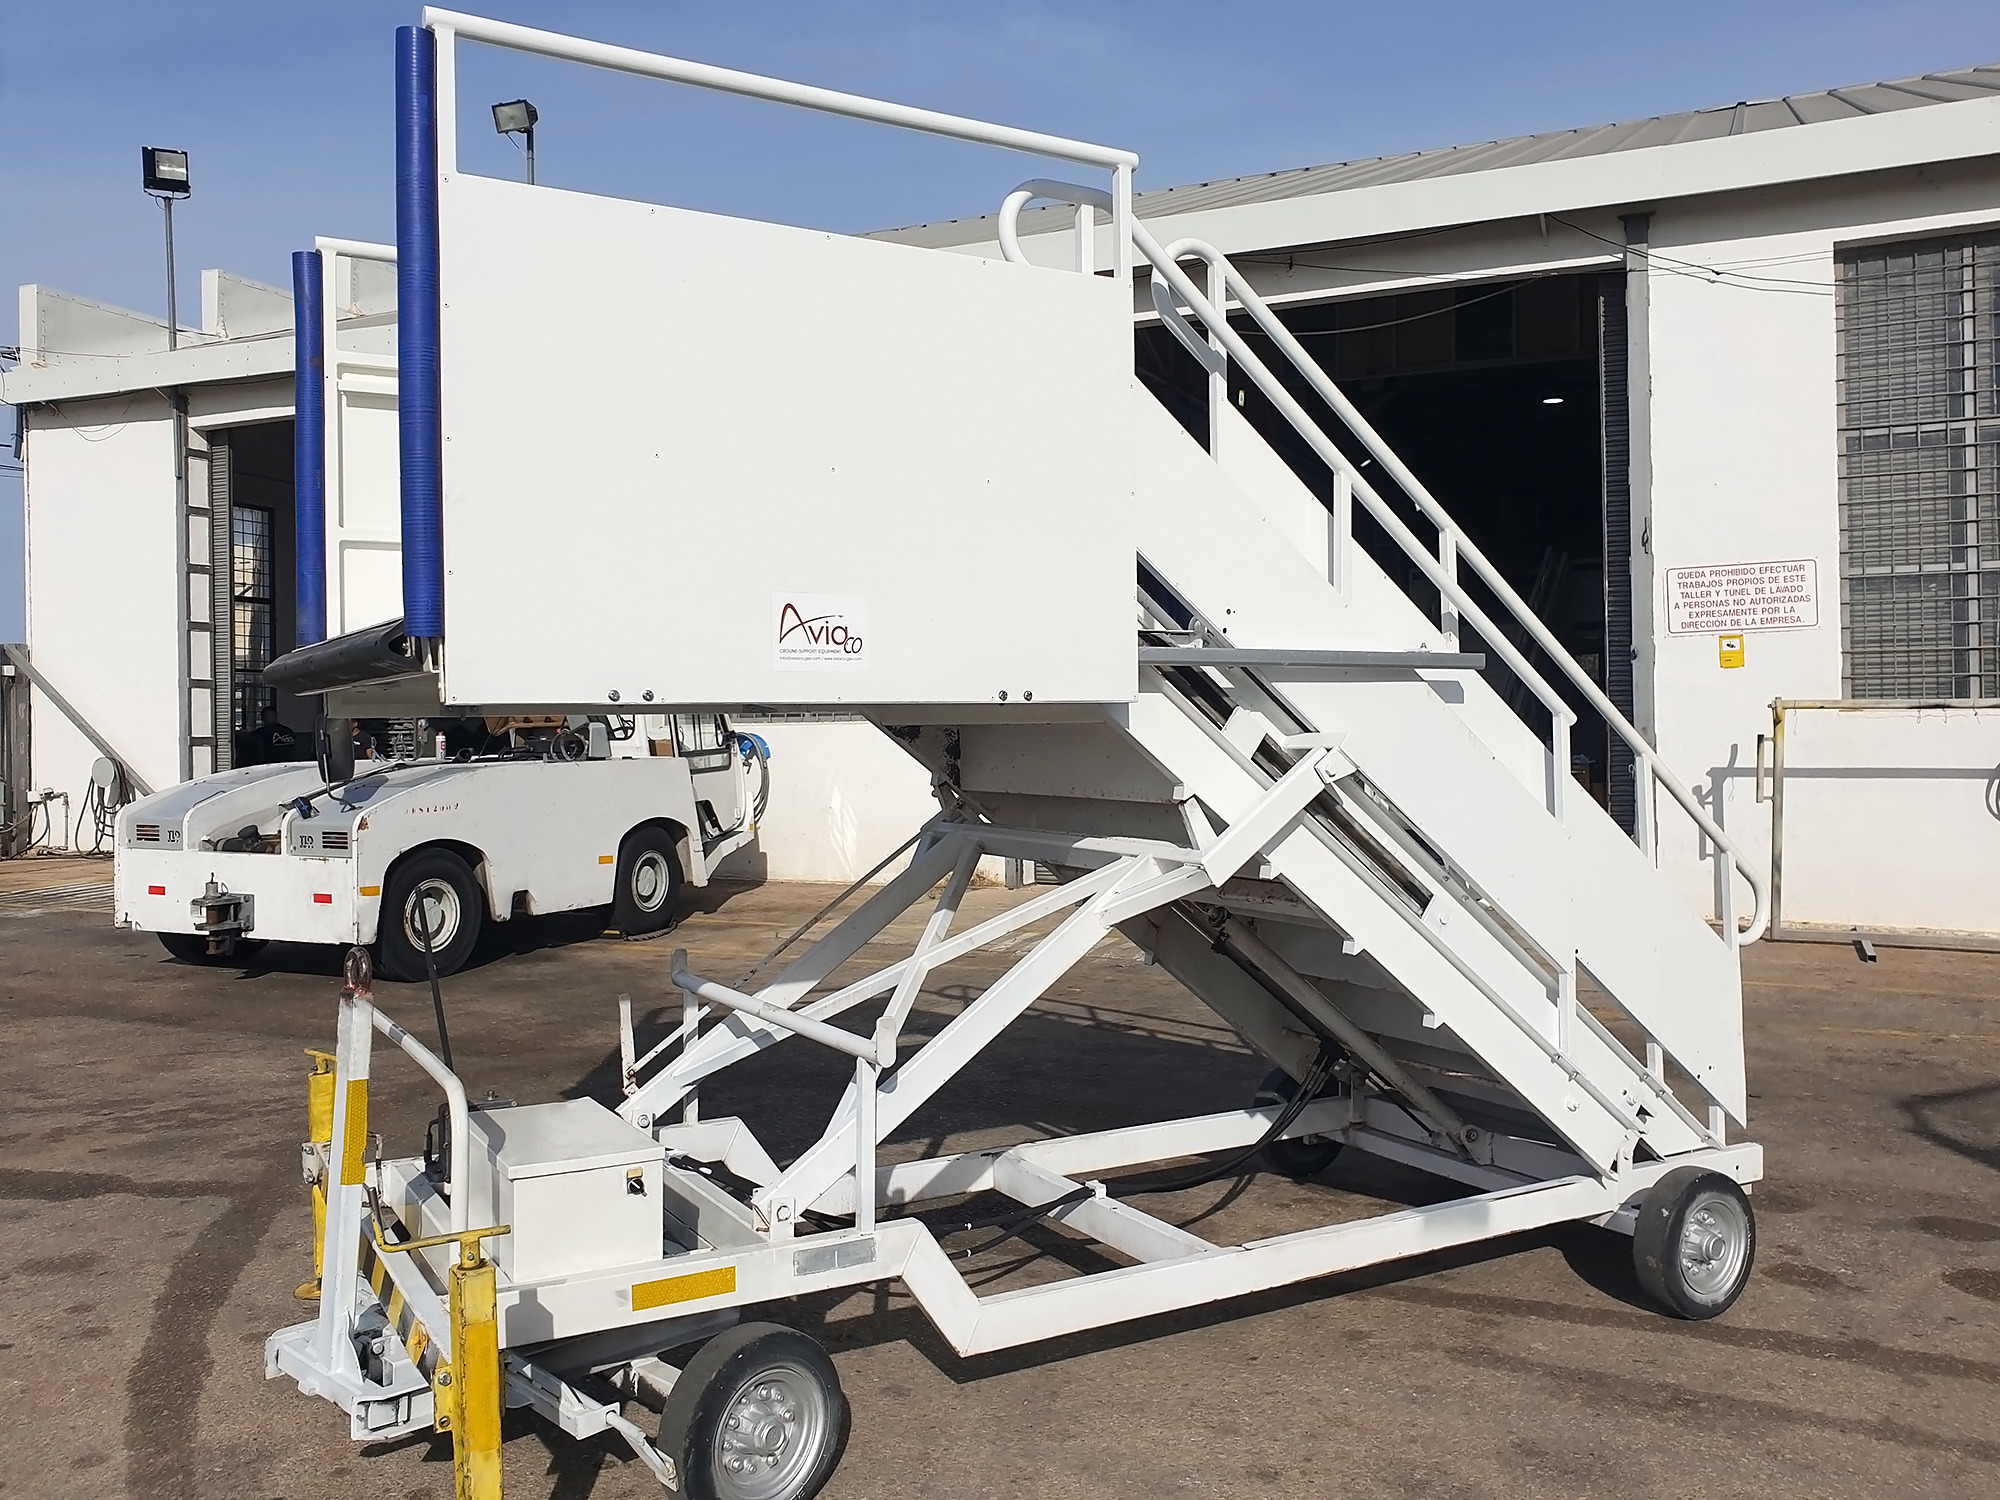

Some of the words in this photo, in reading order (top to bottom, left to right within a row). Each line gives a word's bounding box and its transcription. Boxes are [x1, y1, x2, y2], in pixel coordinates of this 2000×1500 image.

[1677, 570, 1707, 579] QUEDA
[1709, 567, 1756, 577] PROHIBIDO
[1759, 564, 1806, 575] EFECTUAR
[1677, 580, 1723, 590] TRABAJOS
[1726, 577, 1765, 587] PROPIOS
[1768, 576, 1780, 584] DE
[1783, 574, 1806, 583] ESTE
[1680, 591, 1712, 600] TALLER
[1715, 590, 1721, 598] Y
[1723, 587, 1751, 597] TÚNEL
[1754, 586, 1767, 595] DE
[1769, 585, 1804, 594] LAVADO
[1674, 602, 1680, 610] A
[1683, 599, 1730, 609] PERSONAS
[1733, 598, 1746, 606] NO
[1749, 594, 1812, 605] AUTORIZADAS
[1688, 609, 1758, 619] EXPRESAMENTE
[1761, 607, 1780, 615] POR
[1681, 618, 1727, 630] DIRECCIÓN
[1730, 619, 1742, 627] DE
[1745, 618, 1757, 626] LA
[1760, 616, 1805, 625] EMPRESA.
